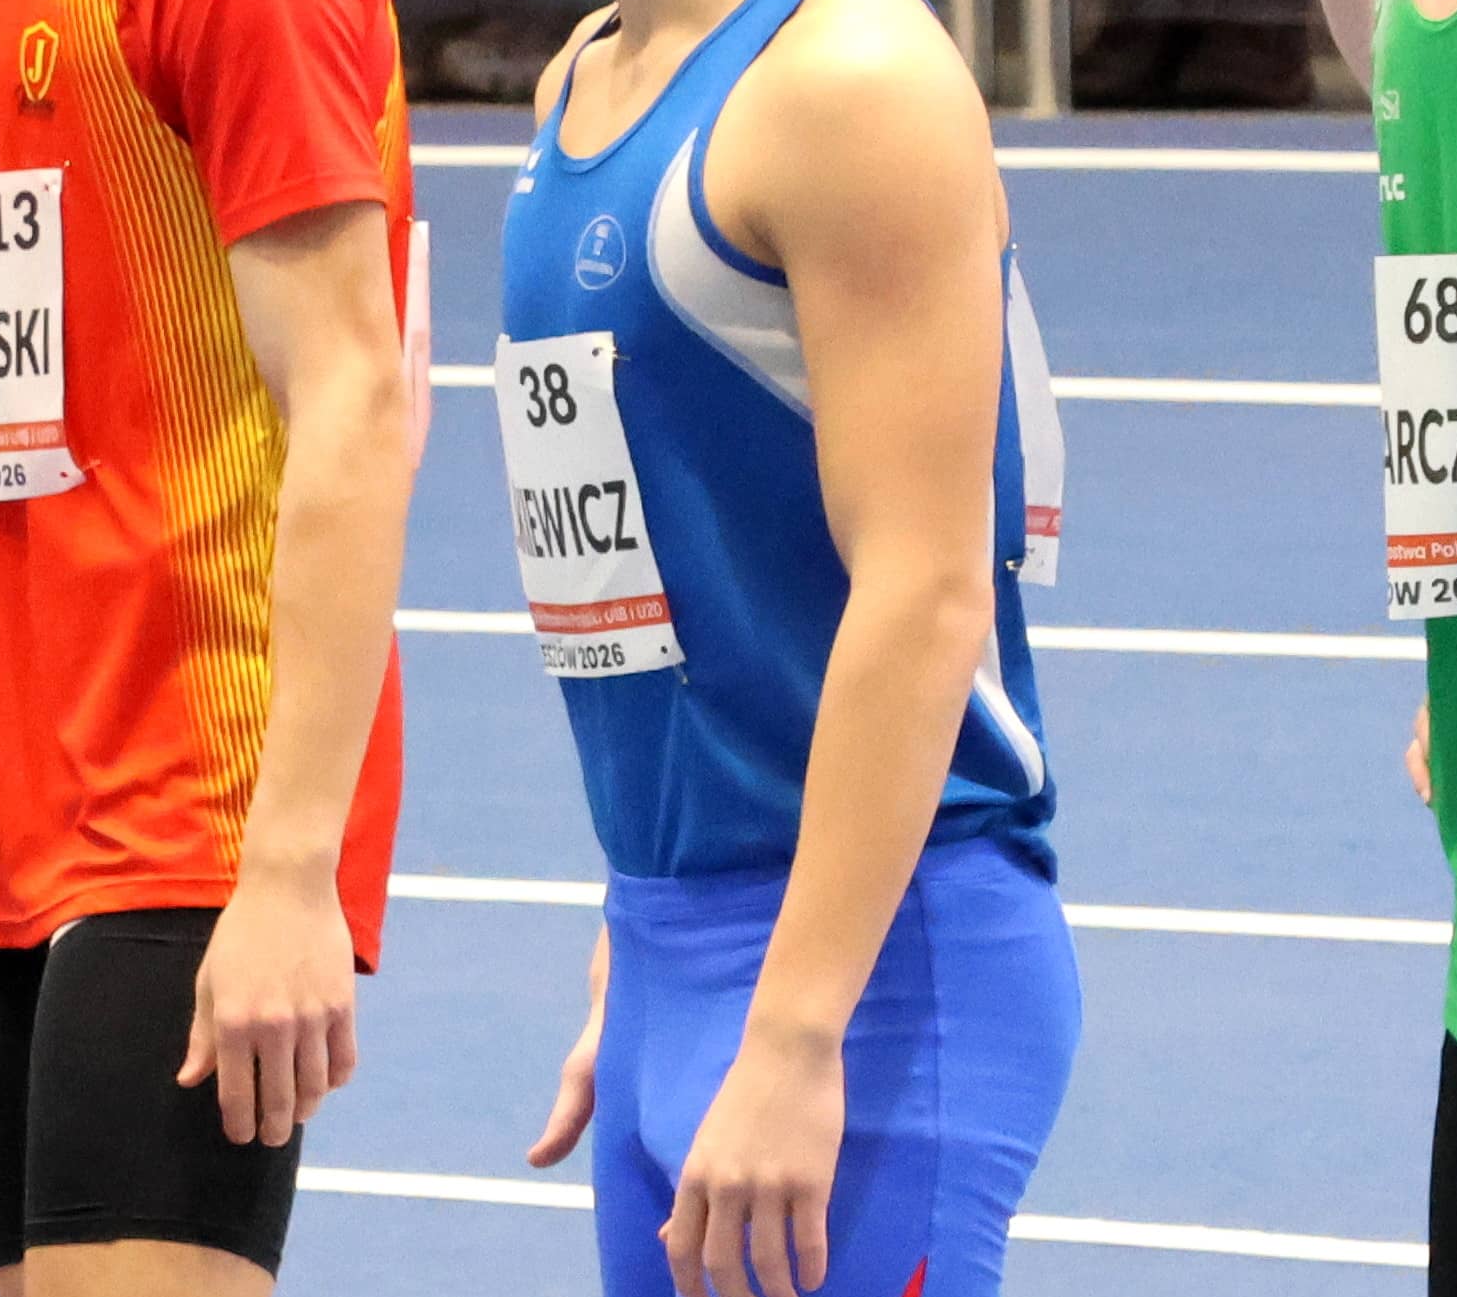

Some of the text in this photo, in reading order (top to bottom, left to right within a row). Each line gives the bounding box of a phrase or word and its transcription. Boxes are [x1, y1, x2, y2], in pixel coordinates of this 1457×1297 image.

[519, 363, 577, 429] 38
[637, 601, 663, 621] U20
[577, 642, 626, 669] 2026
